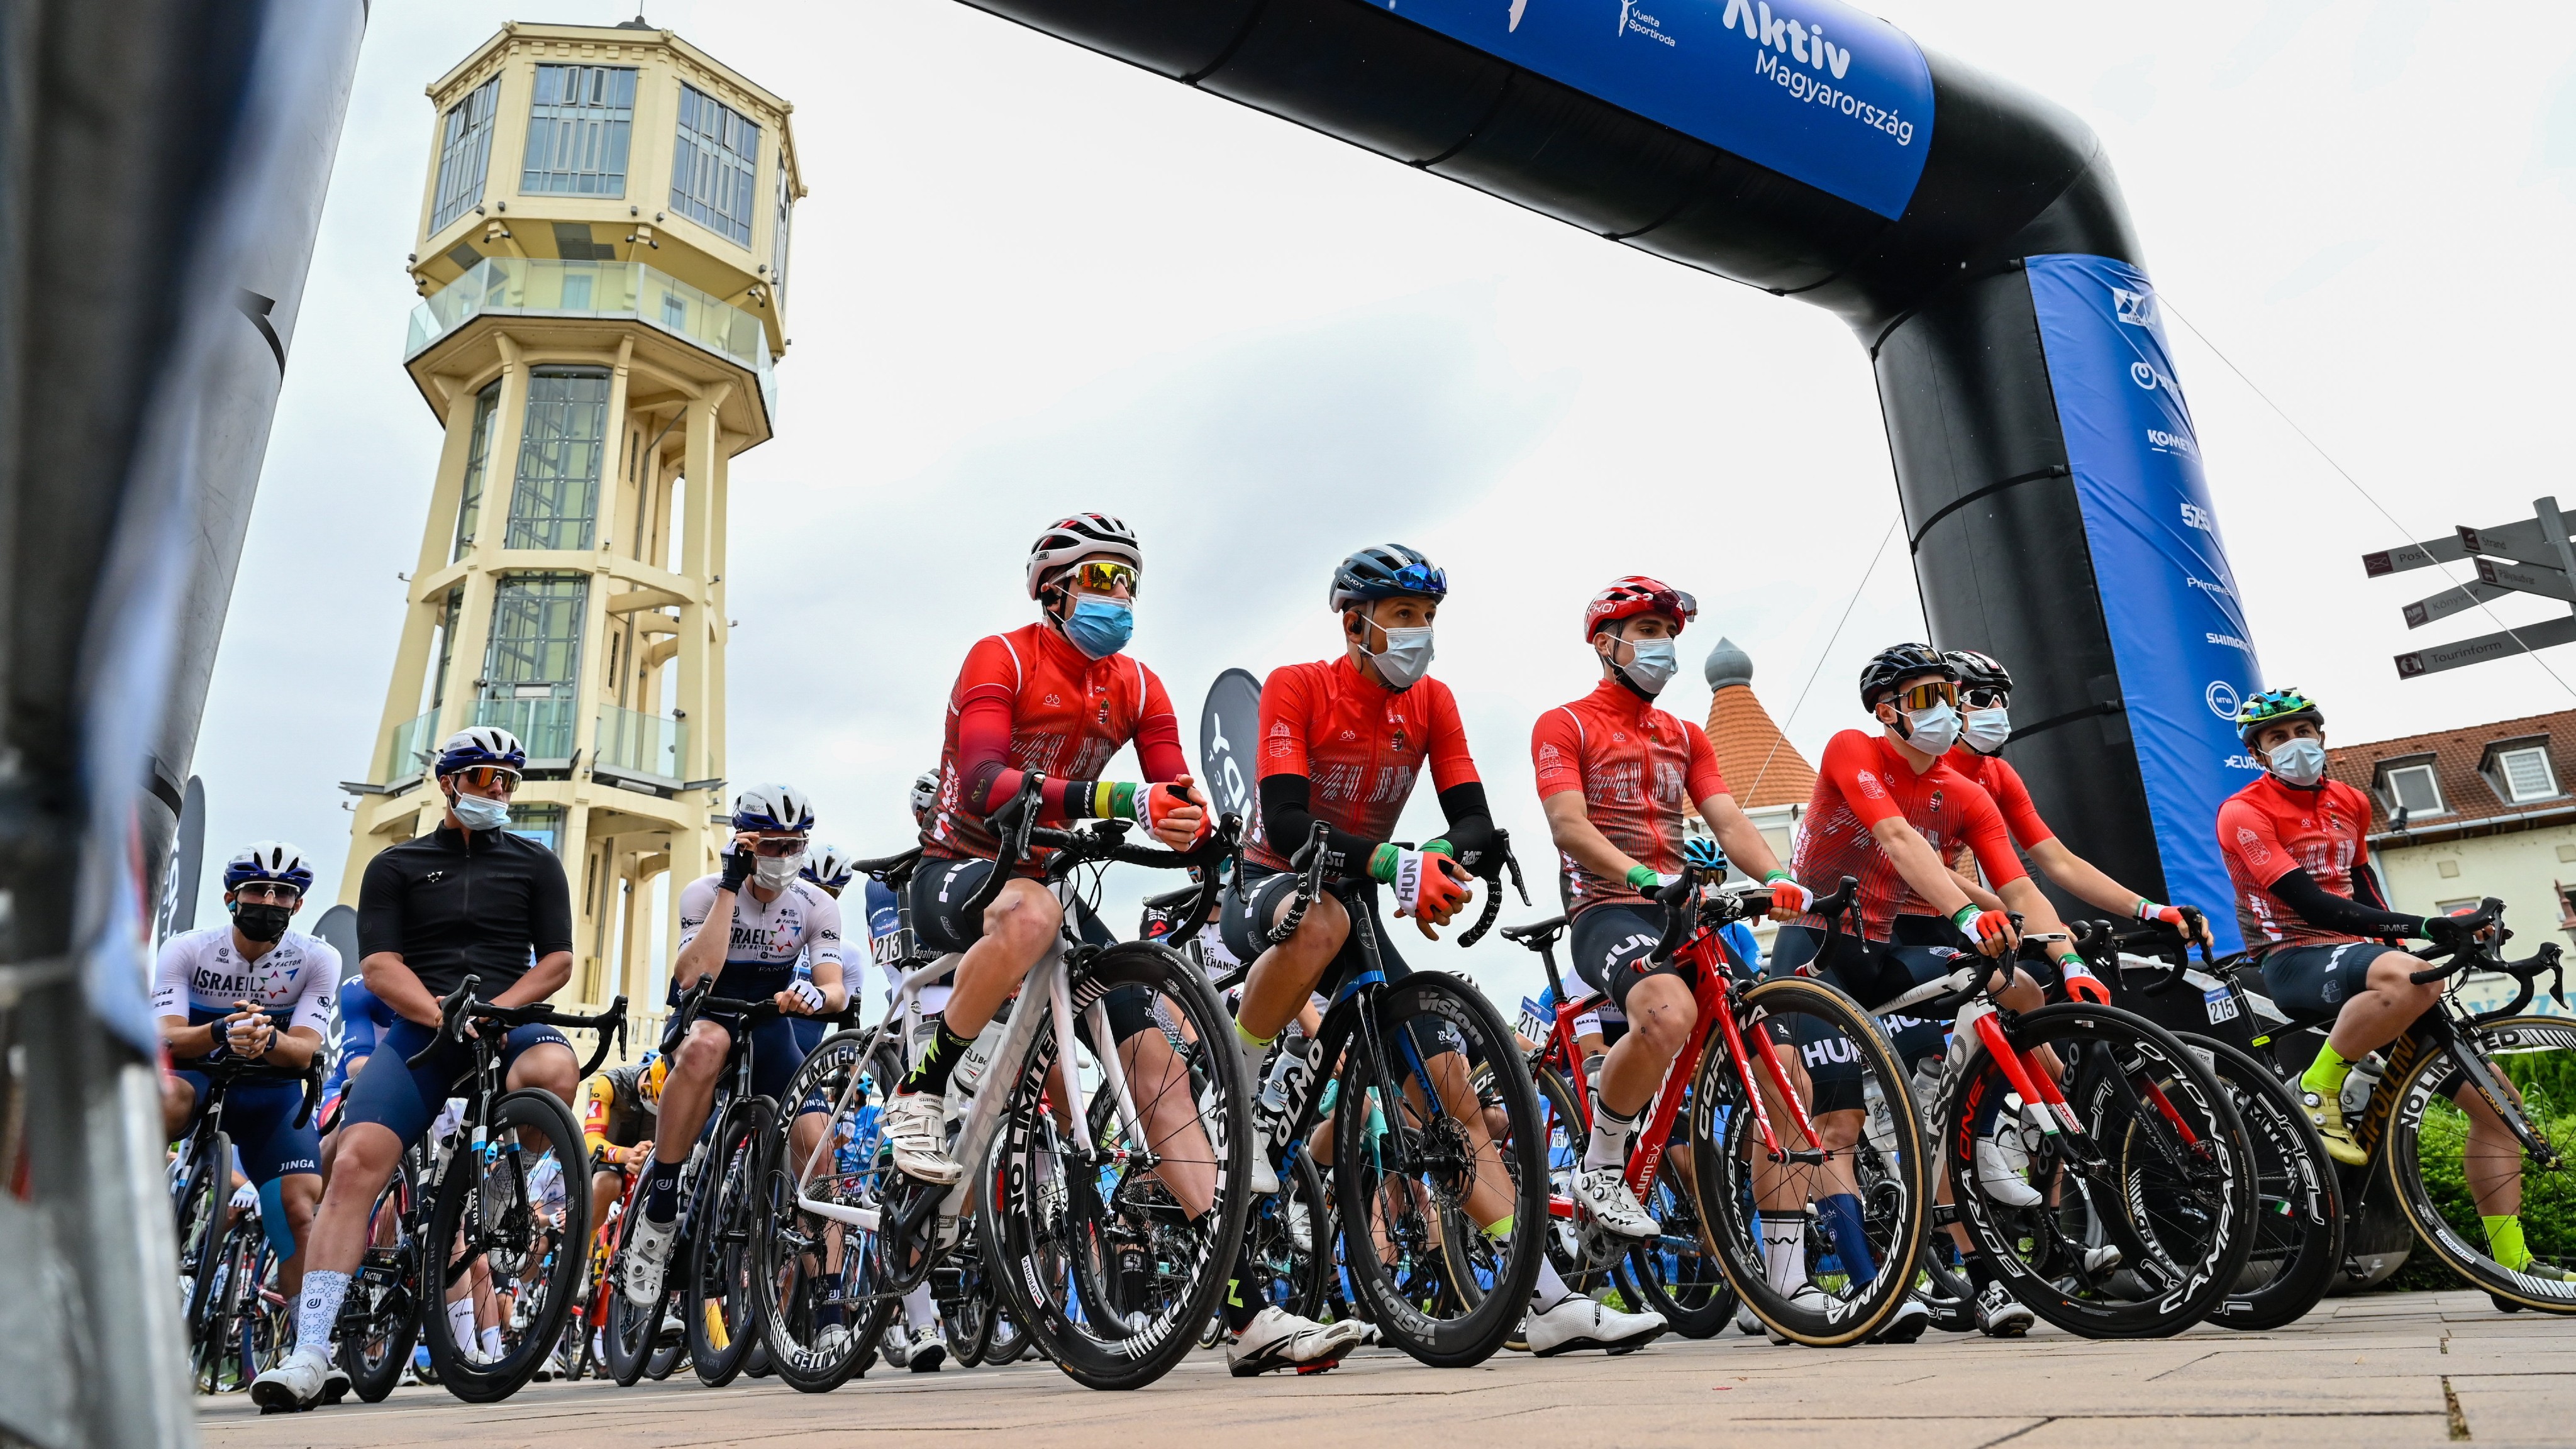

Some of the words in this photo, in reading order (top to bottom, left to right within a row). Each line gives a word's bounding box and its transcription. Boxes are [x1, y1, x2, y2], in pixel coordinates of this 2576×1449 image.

[1628, 19, 1675, 47] Sportiroda
[1632, 8, 1660, 27] Vuelta
[1755, 50, 1913, 145] Magyarország
[2180, 503, 2212, 530] 575
[2399, 548, 2434, 563] Posta
[2482, 538, 2507, 550] Strand
[1343, 574, 1365, 589] RUDY
[2206, 633, 2254, 653] SHIMANO
[2431, 640, 2502, 664] Tourinform
[2216, 696, 2233, 705] MTVA
[1137, 789, 1151, 831] HUN
[1792, 821, 1807, 865] WOW
[1798, 832, 1812, 867] HUNGARY
[1400, 858, 1418, 902] HUN
[275, 959, 302, 968] FACTOR
[875, 932, 901, 965] 213
[193, 966, 257, 992] ISRAEL
[1162, 952, 1199, 987] CONTINENTAL
[192, 988, 228, 998] START-UP
[1418, 990, 1484, 1046] Vision
[1518, 1010, 1540, 1041] 211
[2209, 997, 2235, 1023] 215
[535, 1035, 570, 1047] JINGA
[965, 1062, 981, 1072] eubottle
[777, 1094, 798, 1140] NO
[795, 1045, 857, 1097] LIMITED
[918, 1097, 943, 1107] SHIMANO
[1276, 1039, 1323, 1147] OLMO
[1741, 1060, 1773, 1133] RIDLEY
[2477, 1086, 2504, 1116] BOND
[1342, 1058, 1362, 1163] metron
[1959, 1076, 1986, 1161] ONE
[2057, 1103, 2080, 1134] BASSO
[2400, 1092, 2424, 1133] NO
[1555, 1135, 1565, 1147] 161
[1647, 1143, 1663, 1163] SLX
[2139, 1116, 2173, 1165] COLNAGO
[279, 1159, 316, 1172] JINGA
[2135, 1040, 2235, 1314] CAMPAGNOLO
[1011, 1162, 1028, 1219] NO
[471, 1187, 480, 1227] FACTOR
[1961, 1167, 2026, 1278] BORA
[1826, 1180, 1907, 1324] CORIMA
[2438, 1230, 2466, 1258] EPRONEX
[363, 1270, 382, 1283] FACTOR
[1023, 1257, 1038, 1295] EPRONEX
[1075, 1221, 1096, 1307] metron
[428, 1268, 436, 1312] BLACK
[1372, 1278, 1436, 1346] Vision
